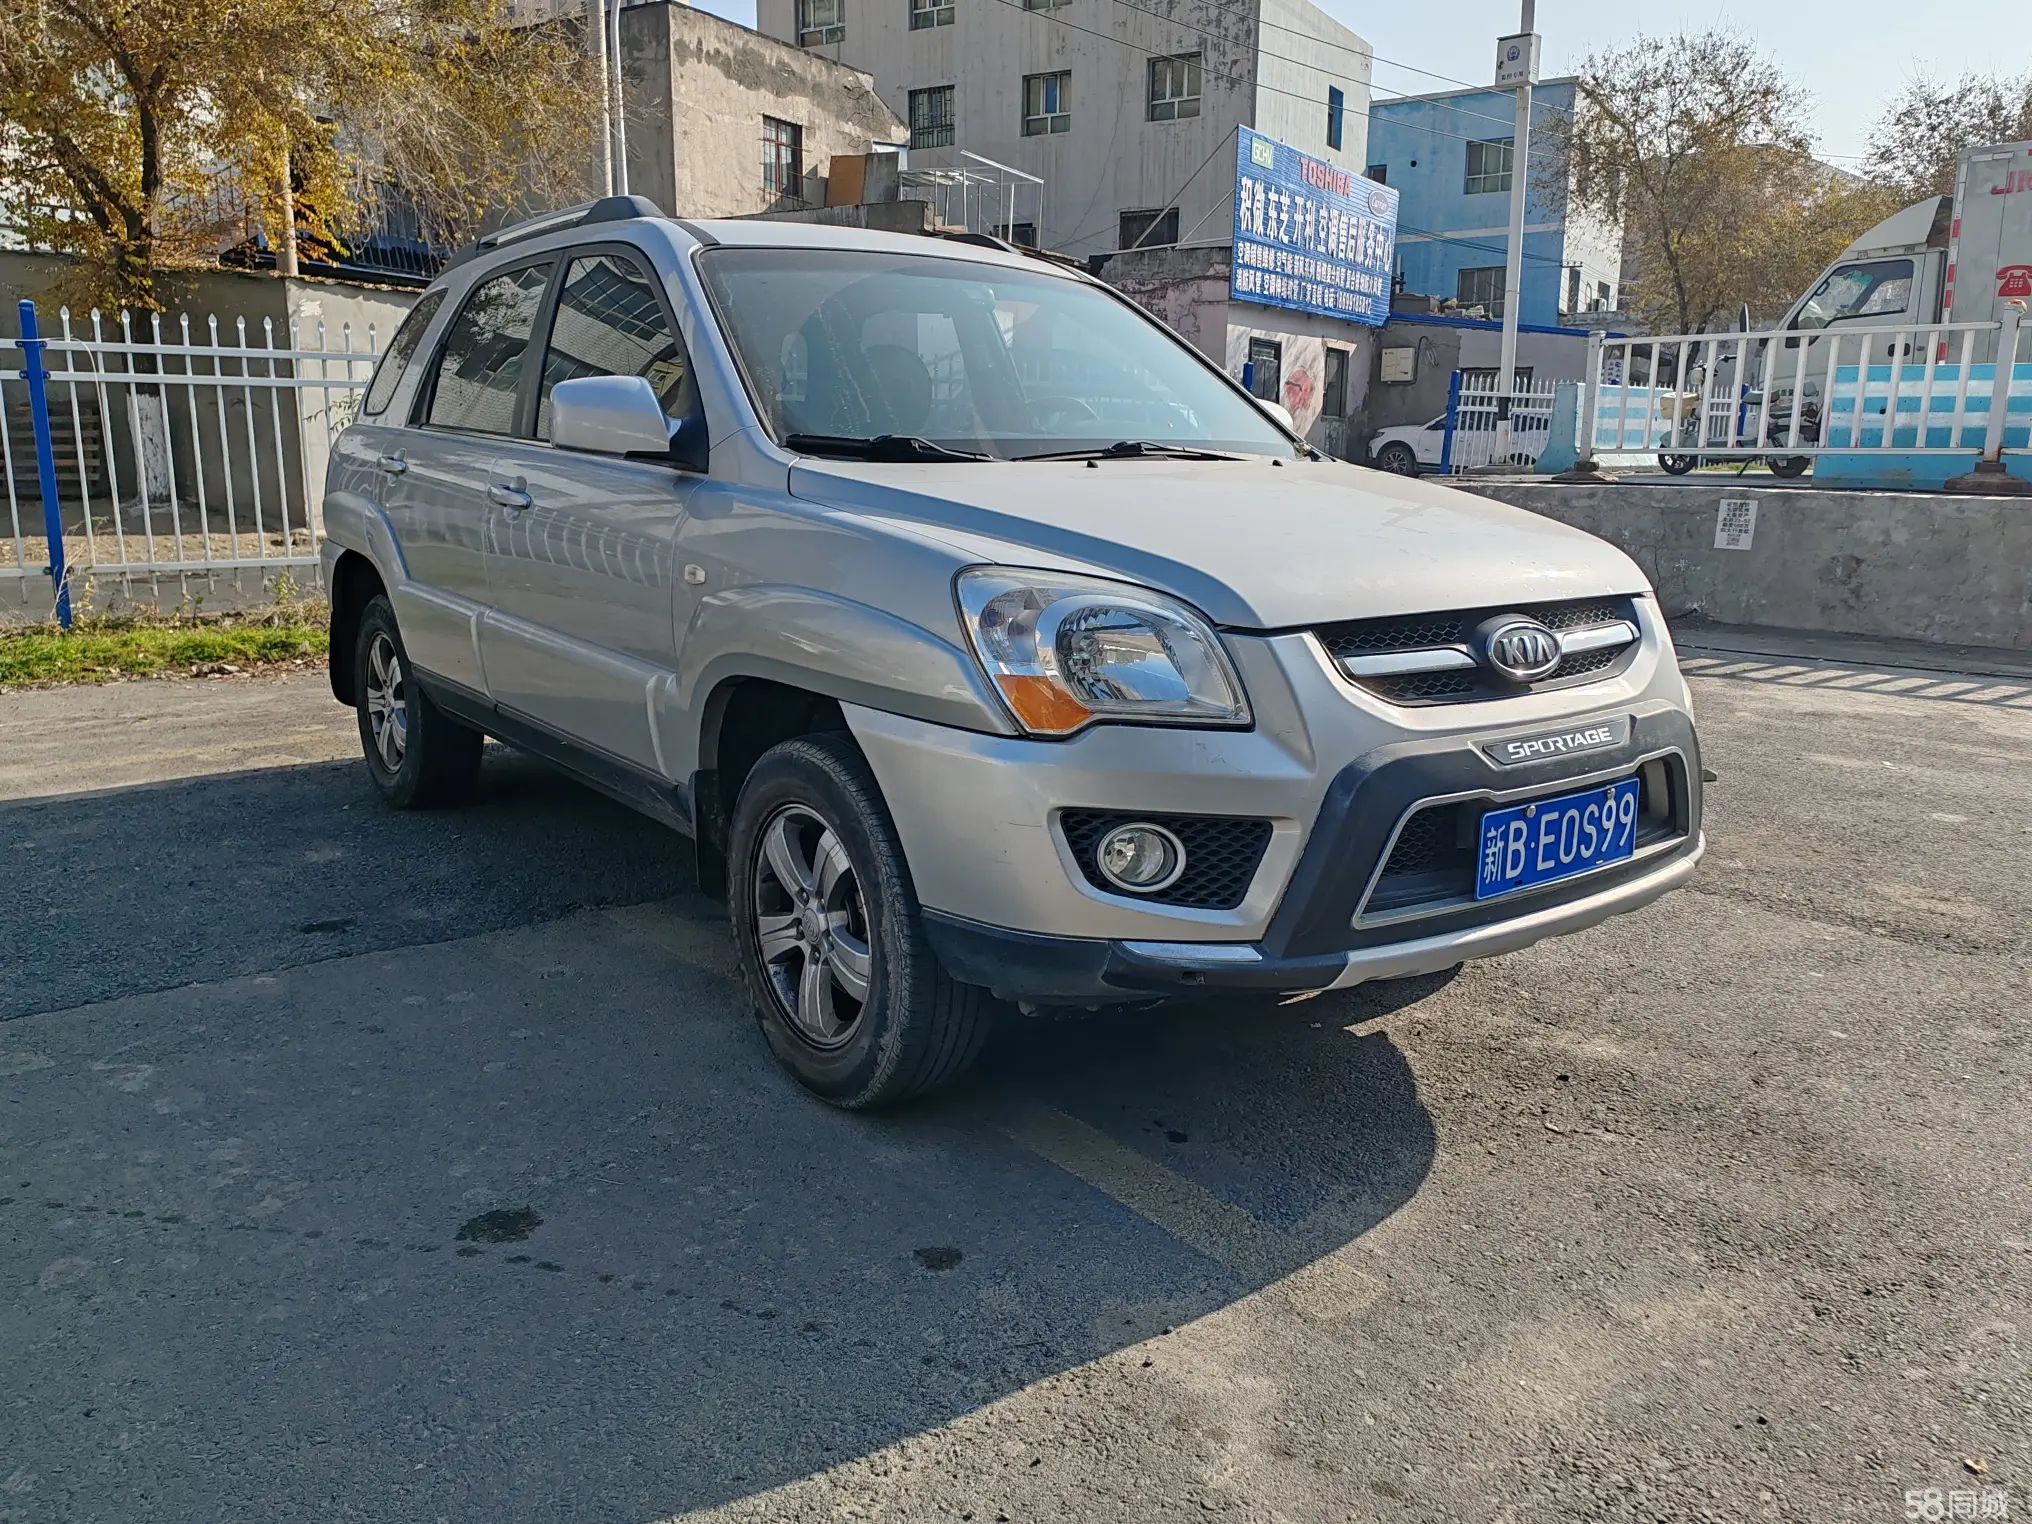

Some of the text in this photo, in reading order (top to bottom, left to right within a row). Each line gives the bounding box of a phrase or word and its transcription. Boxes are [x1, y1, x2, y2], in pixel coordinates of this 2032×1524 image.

[1300, 157, 1352, 198] TOSHIBA
[1240, 176, 1392, 272] 积微 东芝 开利 空调售后服务中心
[1500, 634, 1553, 665] KIA
[1507, 727, 1613, 759] SPORTAGE
